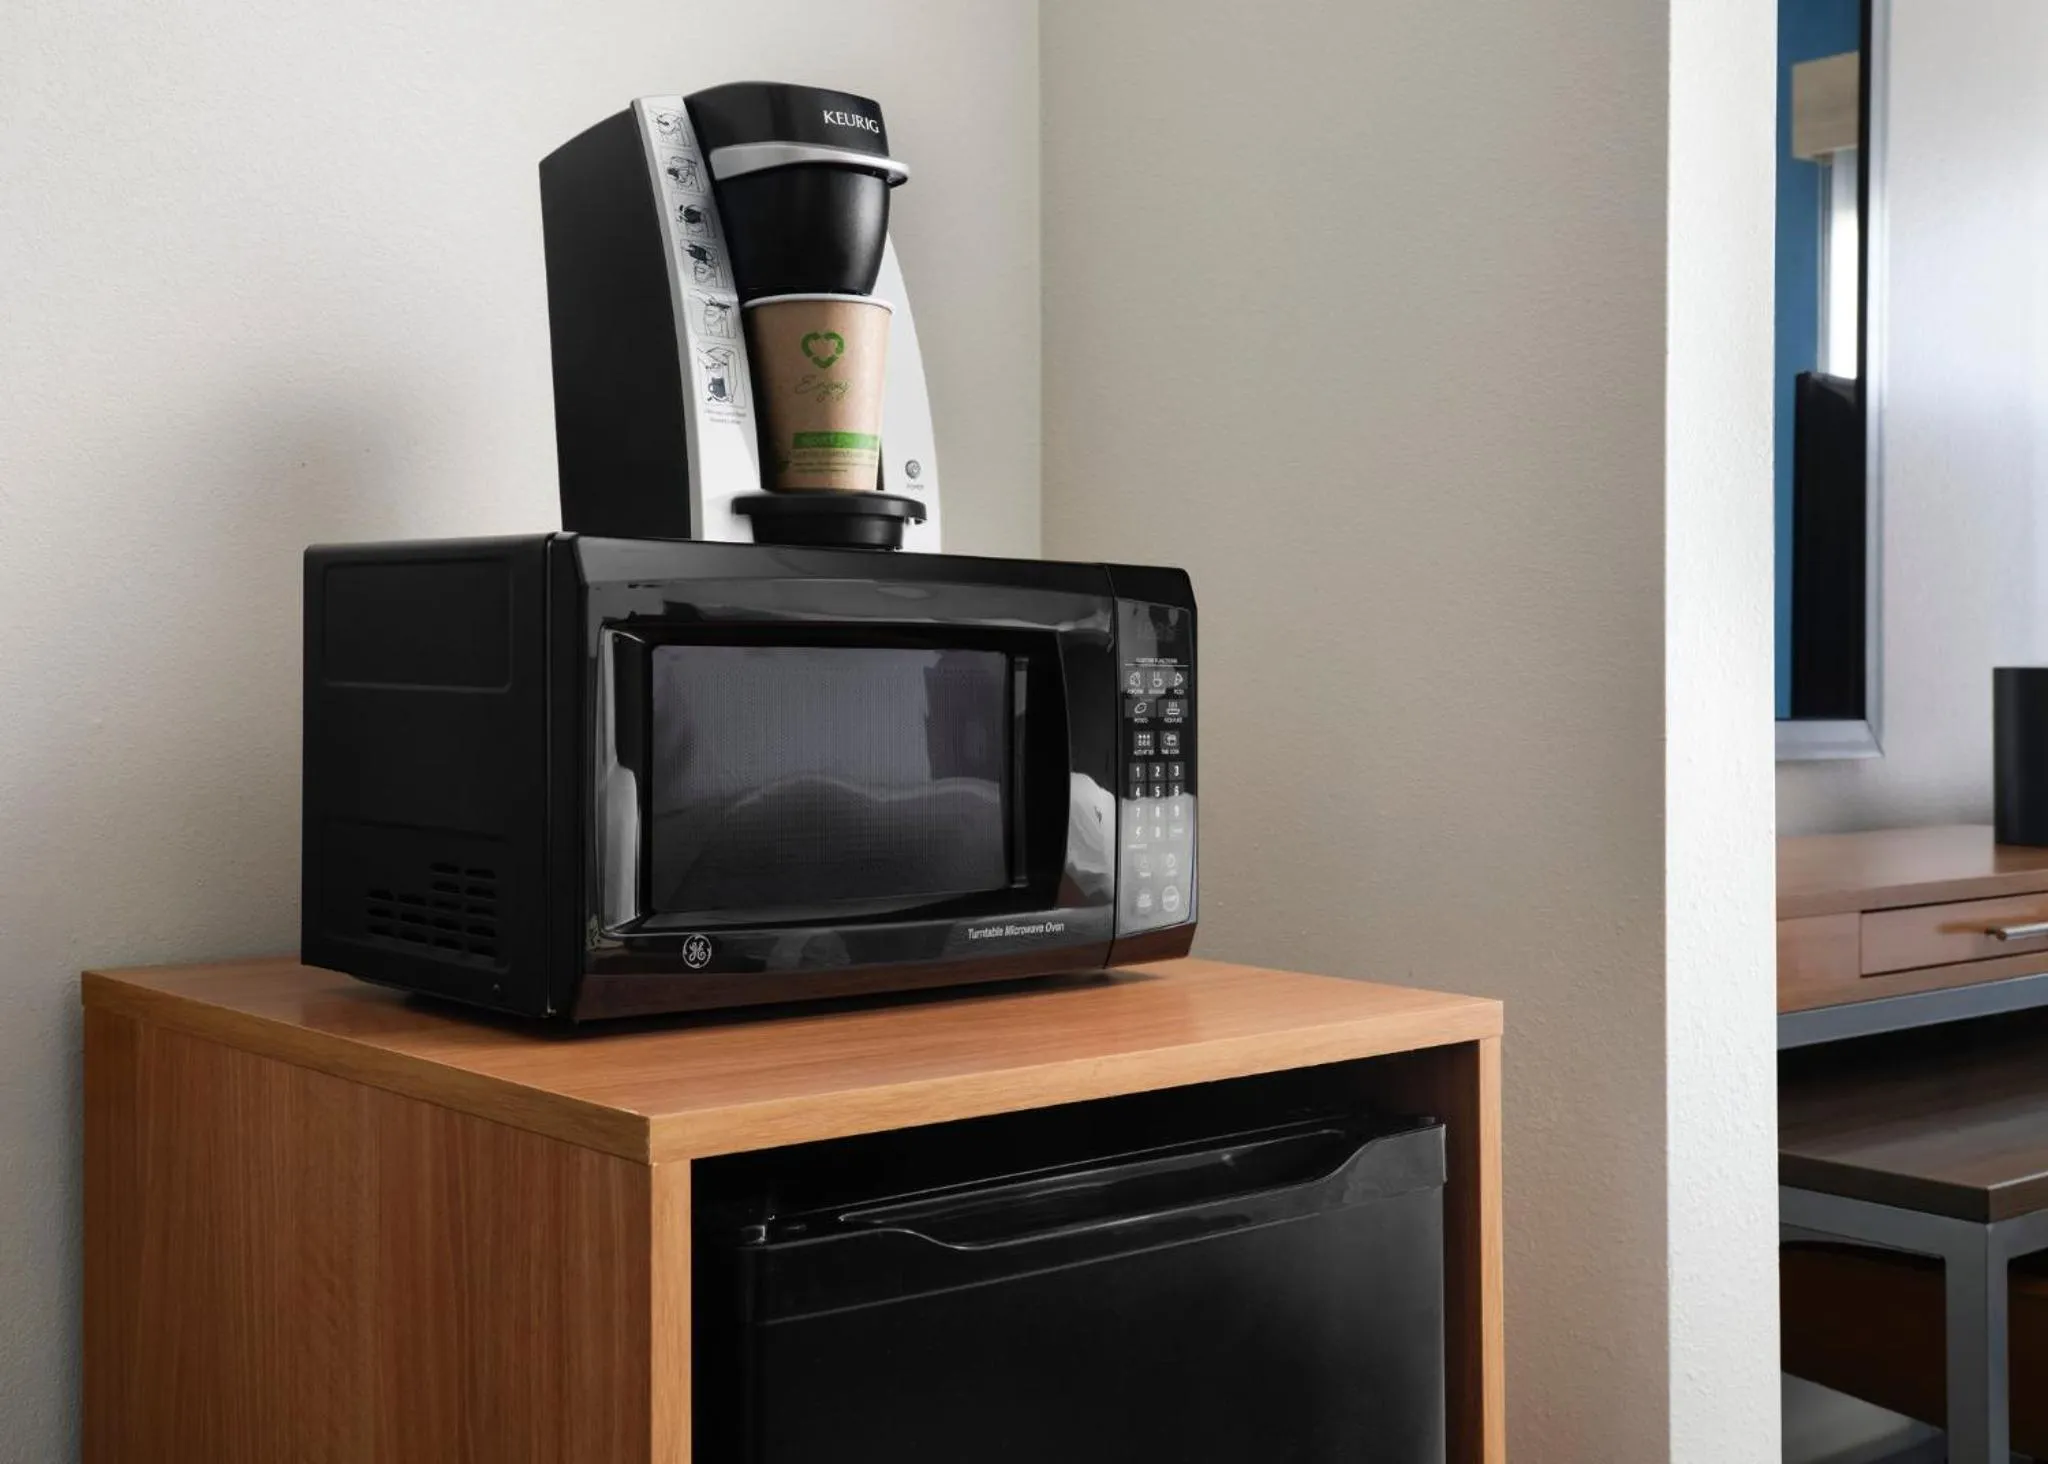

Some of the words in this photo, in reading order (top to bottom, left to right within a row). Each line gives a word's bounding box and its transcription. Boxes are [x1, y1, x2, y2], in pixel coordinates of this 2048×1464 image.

[823, 109, 881, 134] KEURIG
[1135, 765, 1141, 778] 1
[1154, 765, 1161, 778] 2
[1174, 764, 1180, 777] 3
[1135, 786, 1141, 798] 4
[1154, 785, 1161, 798] 5
[968, 927, 1004, 940] Turntable
[1004, 924, 1044, 936] Microwave
[1045, 921, 1065, 933] Oven
